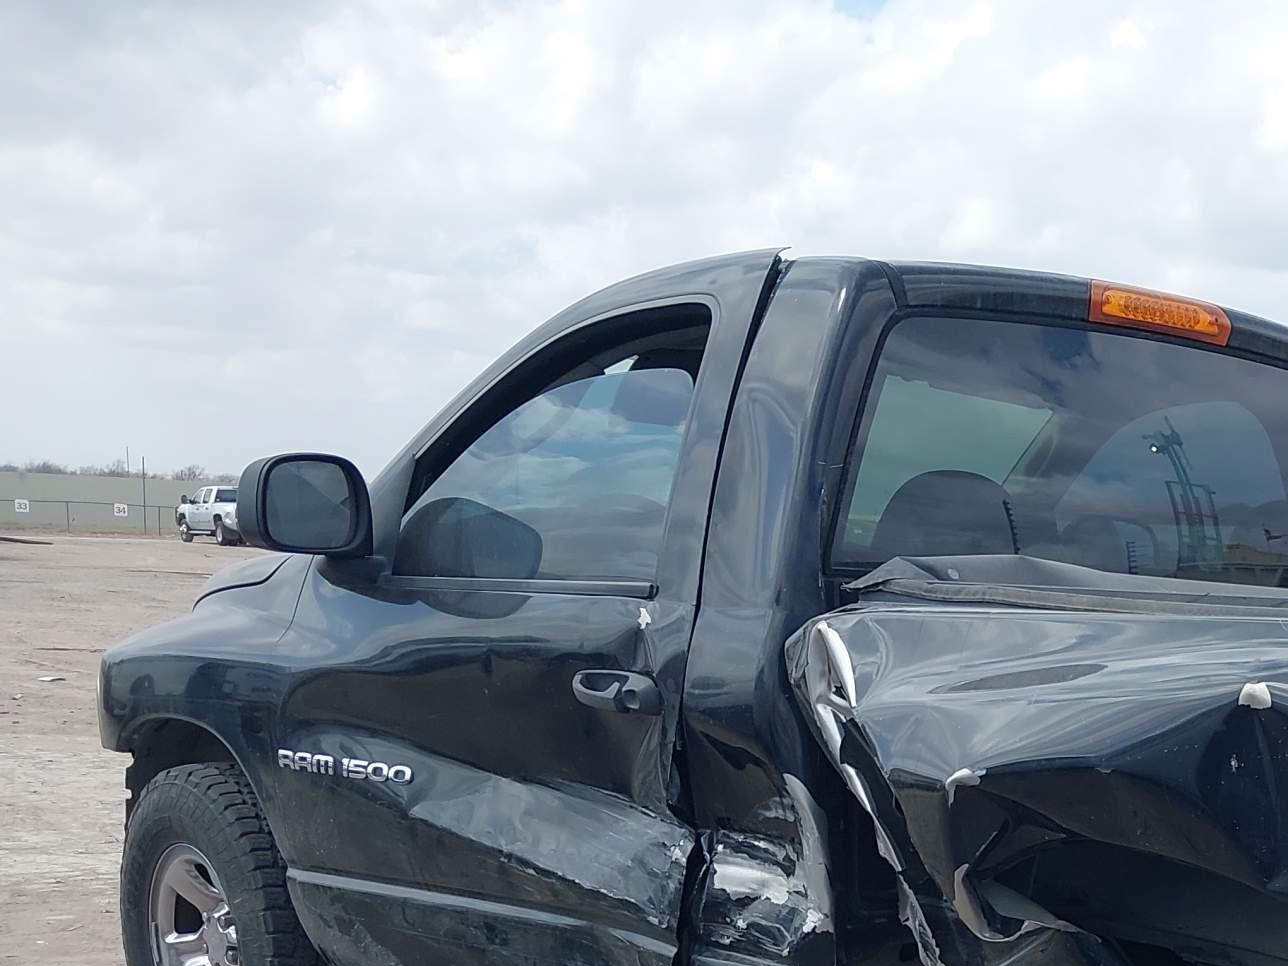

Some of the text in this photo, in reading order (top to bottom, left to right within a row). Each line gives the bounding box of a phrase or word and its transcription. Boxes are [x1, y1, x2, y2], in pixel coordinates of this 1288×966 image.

[16, 502, 28, 511] 33
[116, 507, 126, 515] 34
[278, 749, 414, 785] RAM 1500
